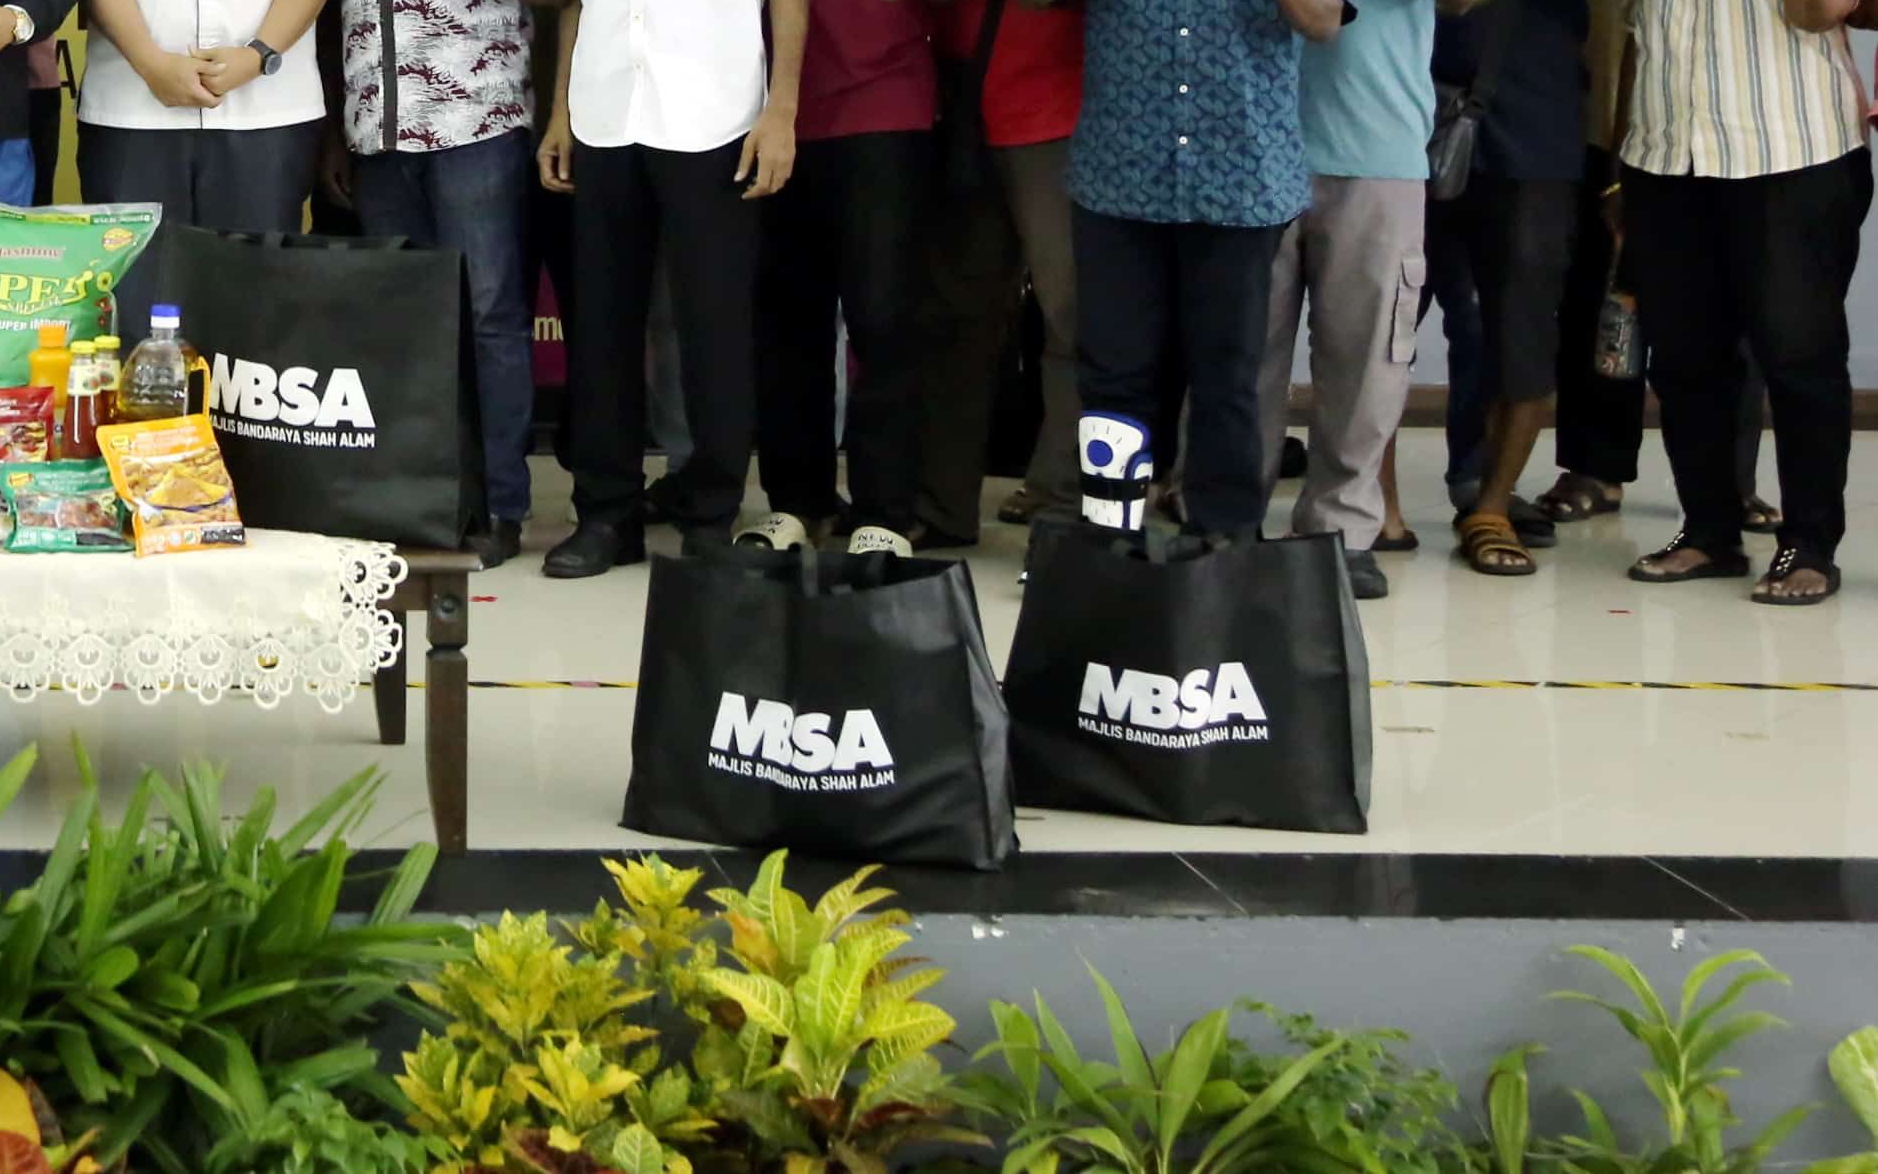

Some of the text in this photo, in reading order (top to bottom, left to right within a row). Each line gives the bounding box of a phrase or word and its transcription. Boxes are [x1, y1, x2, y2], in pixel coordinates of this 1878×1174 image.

[209, 352, 376, 428] MBSA
[237, 421, 301, 444] BANDARAYA
[303, 431, 336, 448] SHAH
[339, 432, 375, 448] ALAM
[1079, 662, 1267, 730] MBSA
[710, 691, 894, 773] MBSA
[1078, 716, 1268, 749] MAJLIS BANDARAYA SHAH ALAM
[708, 752, 753, 775] MAJLIS
[821, 775, 857, 791] SHAH
[860, 770, 895, 789] ALAM
